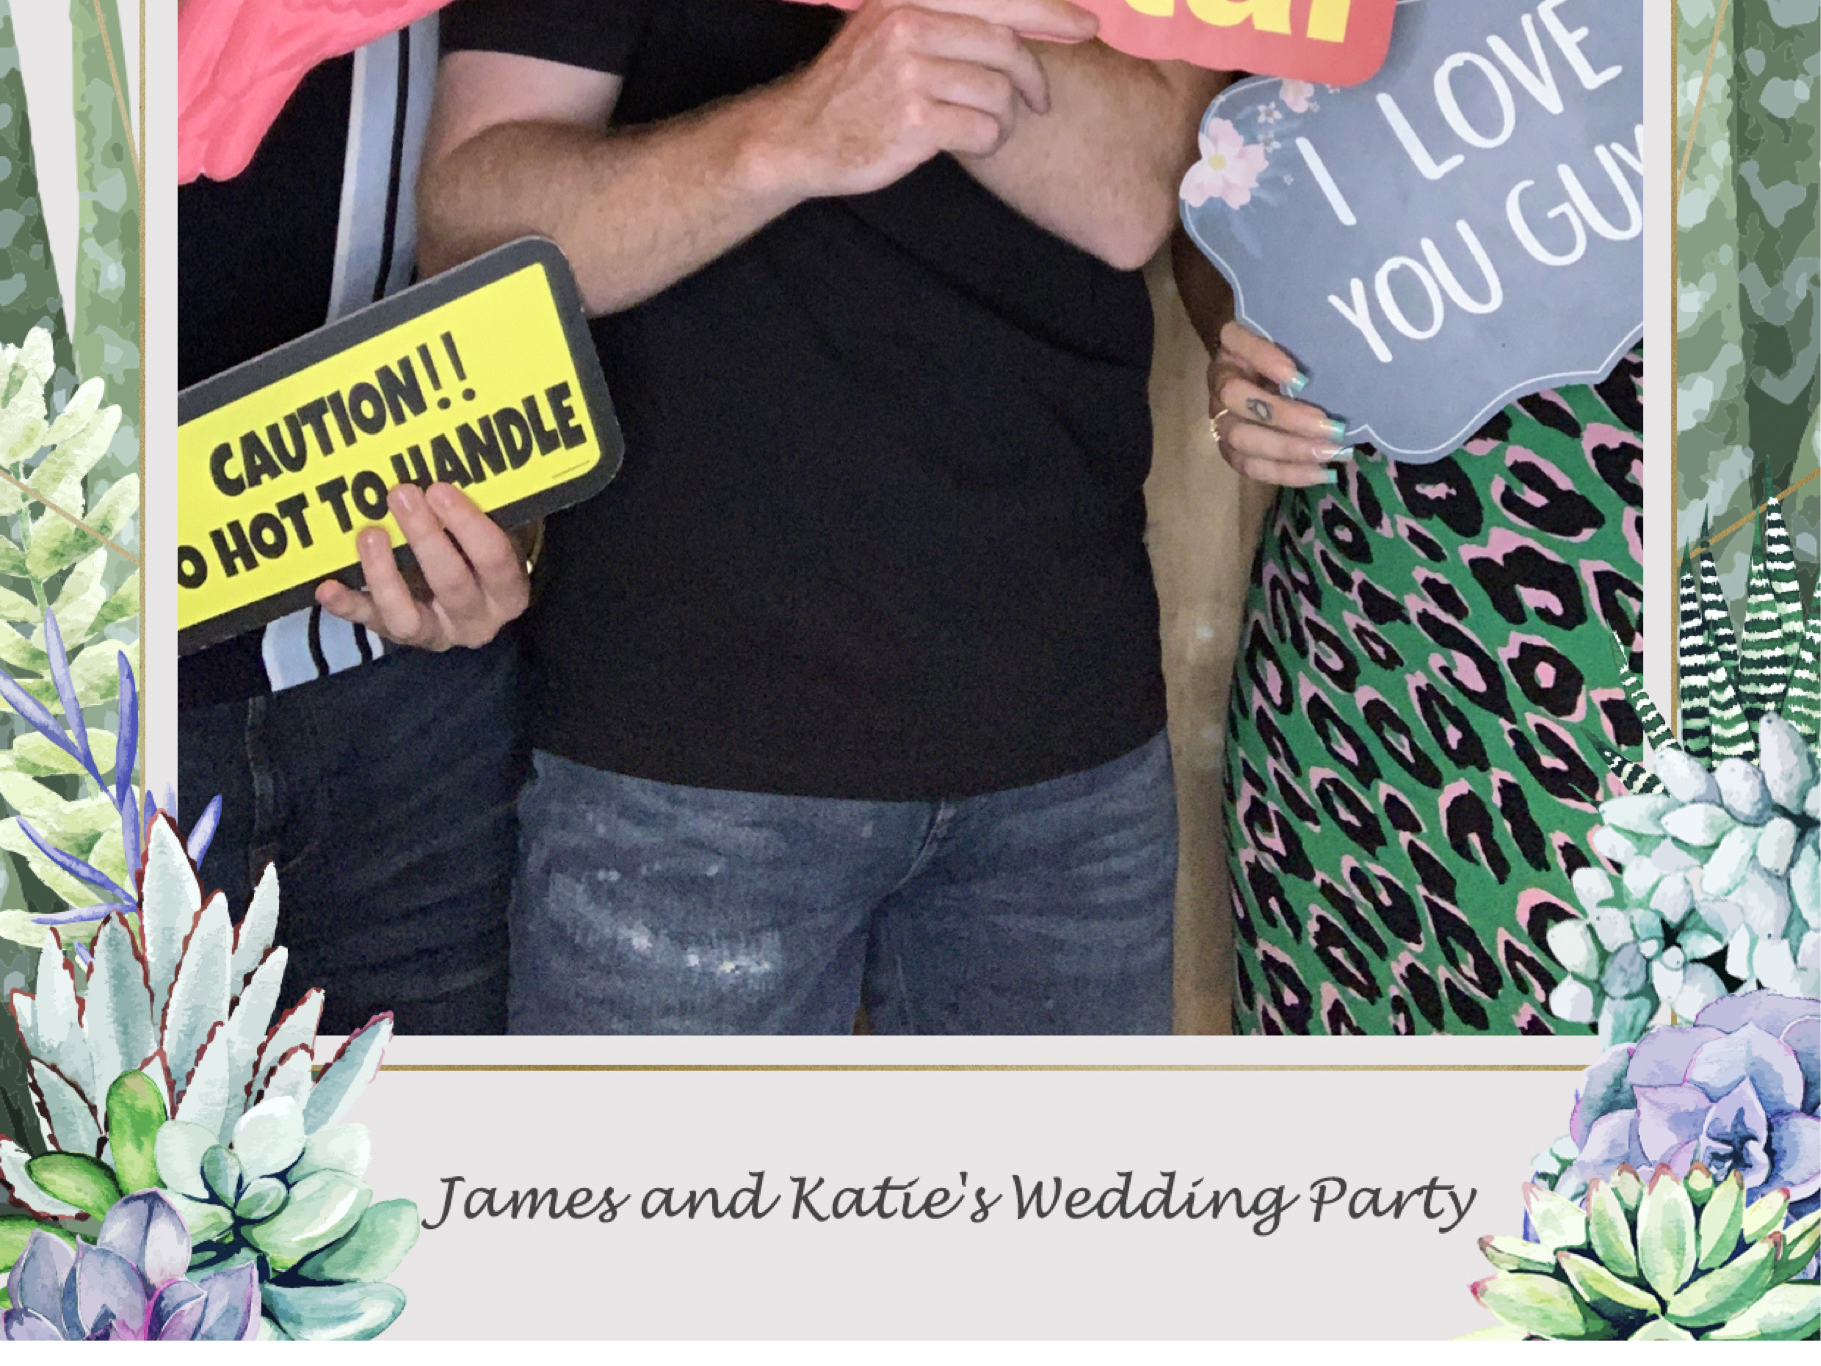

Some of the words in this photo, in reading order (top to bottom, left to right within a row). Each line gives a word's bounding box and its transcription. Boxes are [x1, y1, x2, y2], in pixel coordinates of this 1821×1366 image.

[1295, 137, 1357, 226] I
[1327, 219, 1503, 363] YOU
[208, 493, 313, 578] HOT
[319, 470, 388, 534] TO
[390, 381, 587, 491] HANDLE
[209, 330, 476, 496] CAUTION!!
